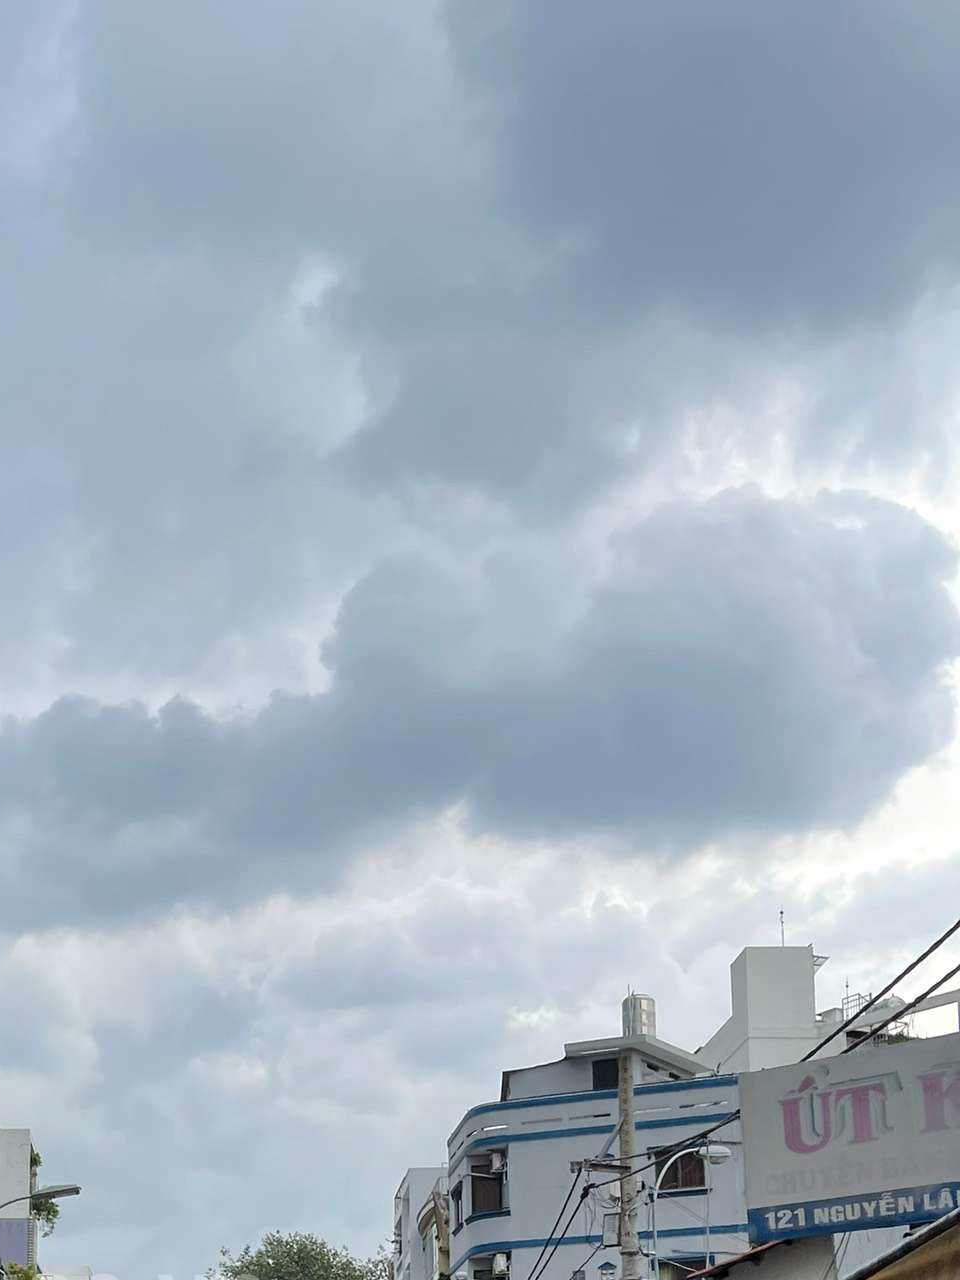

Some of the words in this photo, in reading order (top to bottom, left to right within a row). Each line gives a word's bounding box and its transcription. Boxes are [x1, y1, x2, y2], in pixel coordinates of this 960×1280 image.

[778, 1075, 888, 1154] ÚT
[765, 1207, 807, 1230] 121
[813, 1192, 915, 1226] NGUYỄN
[923, 1188, 960, 1211] LÂ
